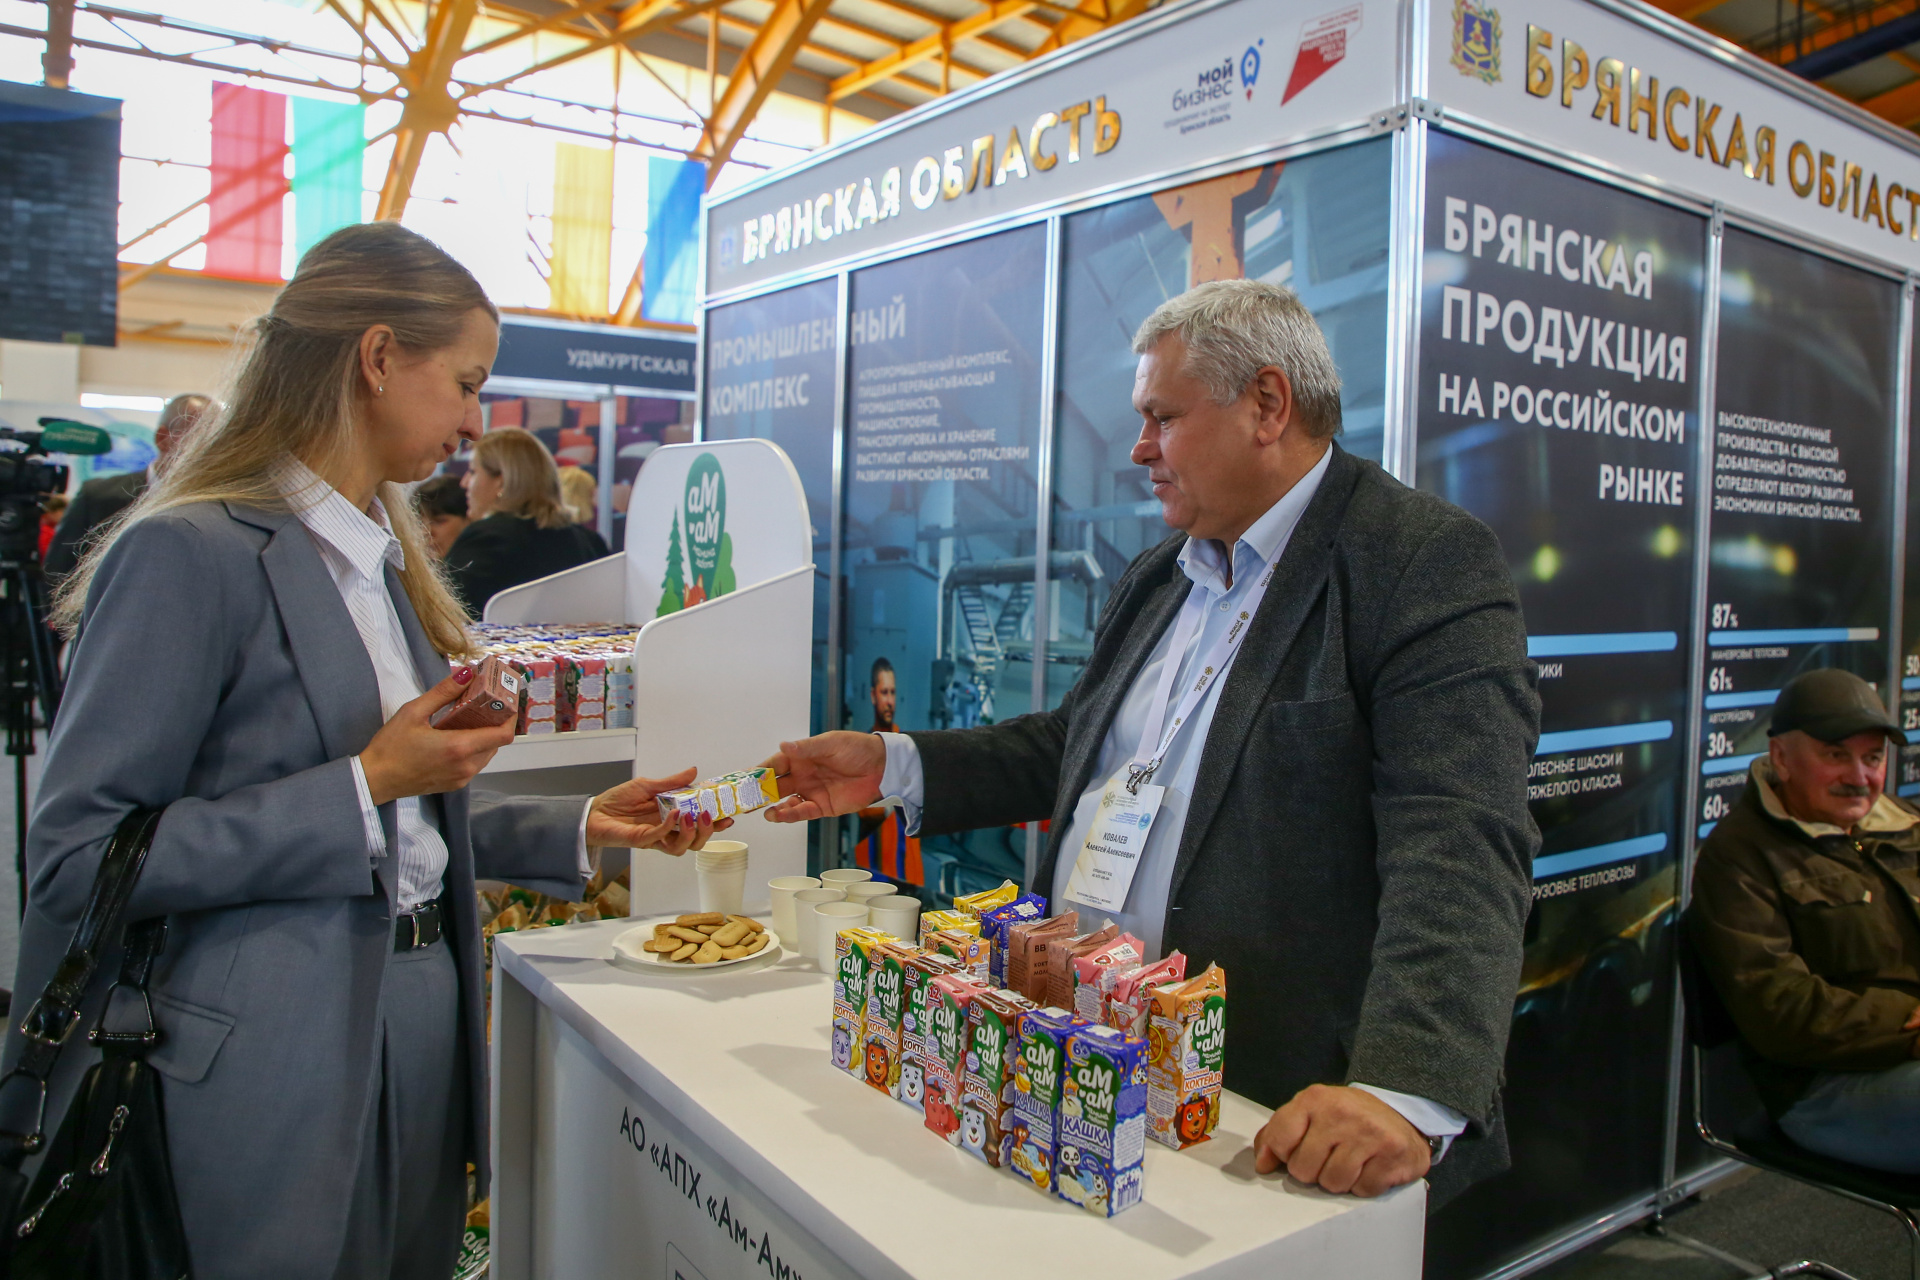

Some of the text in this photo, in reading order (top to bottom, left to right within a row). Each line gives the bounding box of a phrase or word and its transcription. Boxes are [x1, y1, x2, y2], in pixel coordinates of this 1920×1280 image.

[1525, 23, 1777, 186] БРЯНСКАЯ
[742, 94, 1122, 265] БРЯНСКАЯ ОБЛАСТЬ
[1444, 196, 1653, 300] БРЯНСКАЯ
[1442, 285, 1687, 383] ПРОДУКЦИЯ
[566, 348, 689, 376] УДМУРТСКАЯ
[710, 373, 810, 417] КОМПЛЕКС
[1438, 373, 1685, 445] НА РОССИЙСКОМ
[1718, 411, 1832, 444] ВЫСОКОТЕХНОЛОГИЧНЫЕ
[1717, 432, 1839, 463] ПРОИЗВОДСТВА С ВЫСОКОЙ
[1716, 453, 1846, 483] ДОБАВЛЕННОЙ СТОИМОСТЬЮ
[1599, 463, 1684, 506] РЫНКЕ
[1715, 475, 1778, 494] ОПРЕДЕЛЯЮТ
[1779, 482, 1811, 498] ВЕКТОР
[1714, 495, 1775, 515] ЭКОНОМИКИ
[1776, 501, 1821, 519] БРЯНСКОЙ
[1712, 604, 1738, 628] 87%
[1709, 667, 1733, 692] 61%
[1707, 731, 1734, 757] 30%
[1577, 752, 1614, 771] ШАССИ
[1615, 752, 1623, 765] И
[1581, 773, 1622, 792] КЛАССА
[1103, 832, 1128, 844] КОВАЛЕВ
[1579, 864, 1636, 889] ТЕПЛОВОЗЫ
[1184, 1071, 1222, 1092] КОКТЕЙЛЬ
[1015, 1090, 1052, 1124] КАШКА
[1063, 1114, 1110, 1150] КАШКА
[620, 1106, 645, 1152] АО
[650, 1142, 701, 1209] «АПХ
